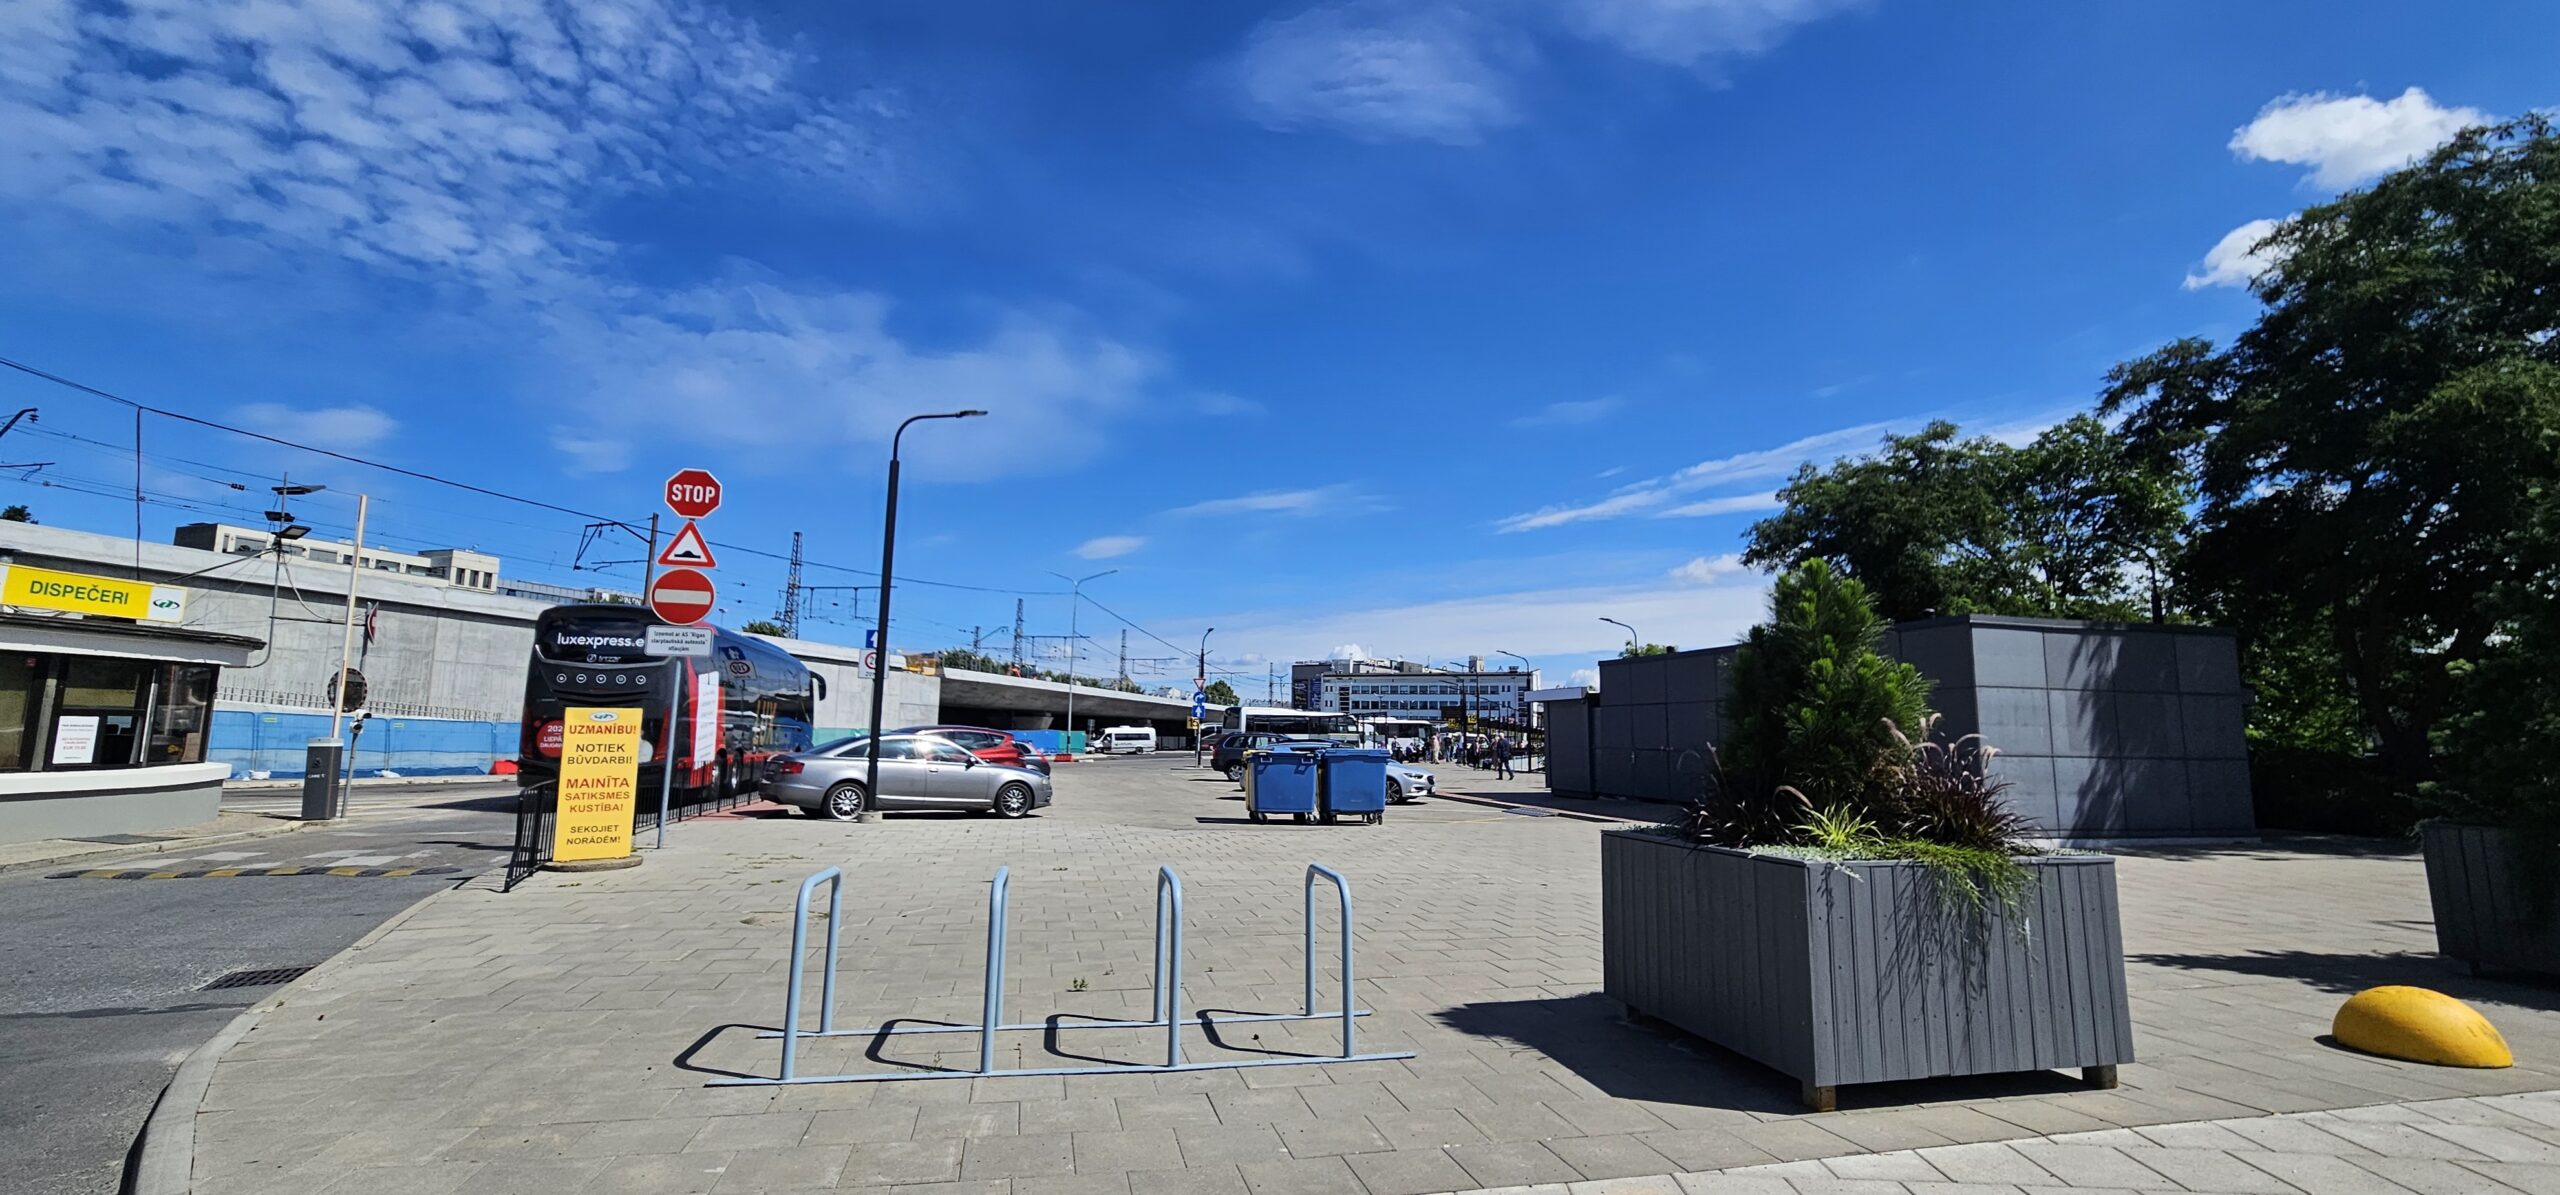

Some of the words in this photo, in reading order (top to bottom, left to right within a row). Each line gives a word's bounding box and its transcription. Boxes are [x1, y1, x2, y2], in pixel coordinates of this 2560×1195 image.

[671, 484, 715, 504] STOP
[30, 580, 129, 605] DISPEČERI
[569, 724, 636, 735] UZMANĪBU!
[575, 743, 625, 753] NOTIEK
[567, 754, 632, 765] BŪVDARBI!
[566, 775, 630, 789] MAINĪTA
[565, 791, 630, 801] SATIKSMES
[569, 803, 623, 813] KUSTĪBA!
[570, 825, 619, 834] SEKOJIET
[566, 836, 621, 845] NORĀDĒM!
